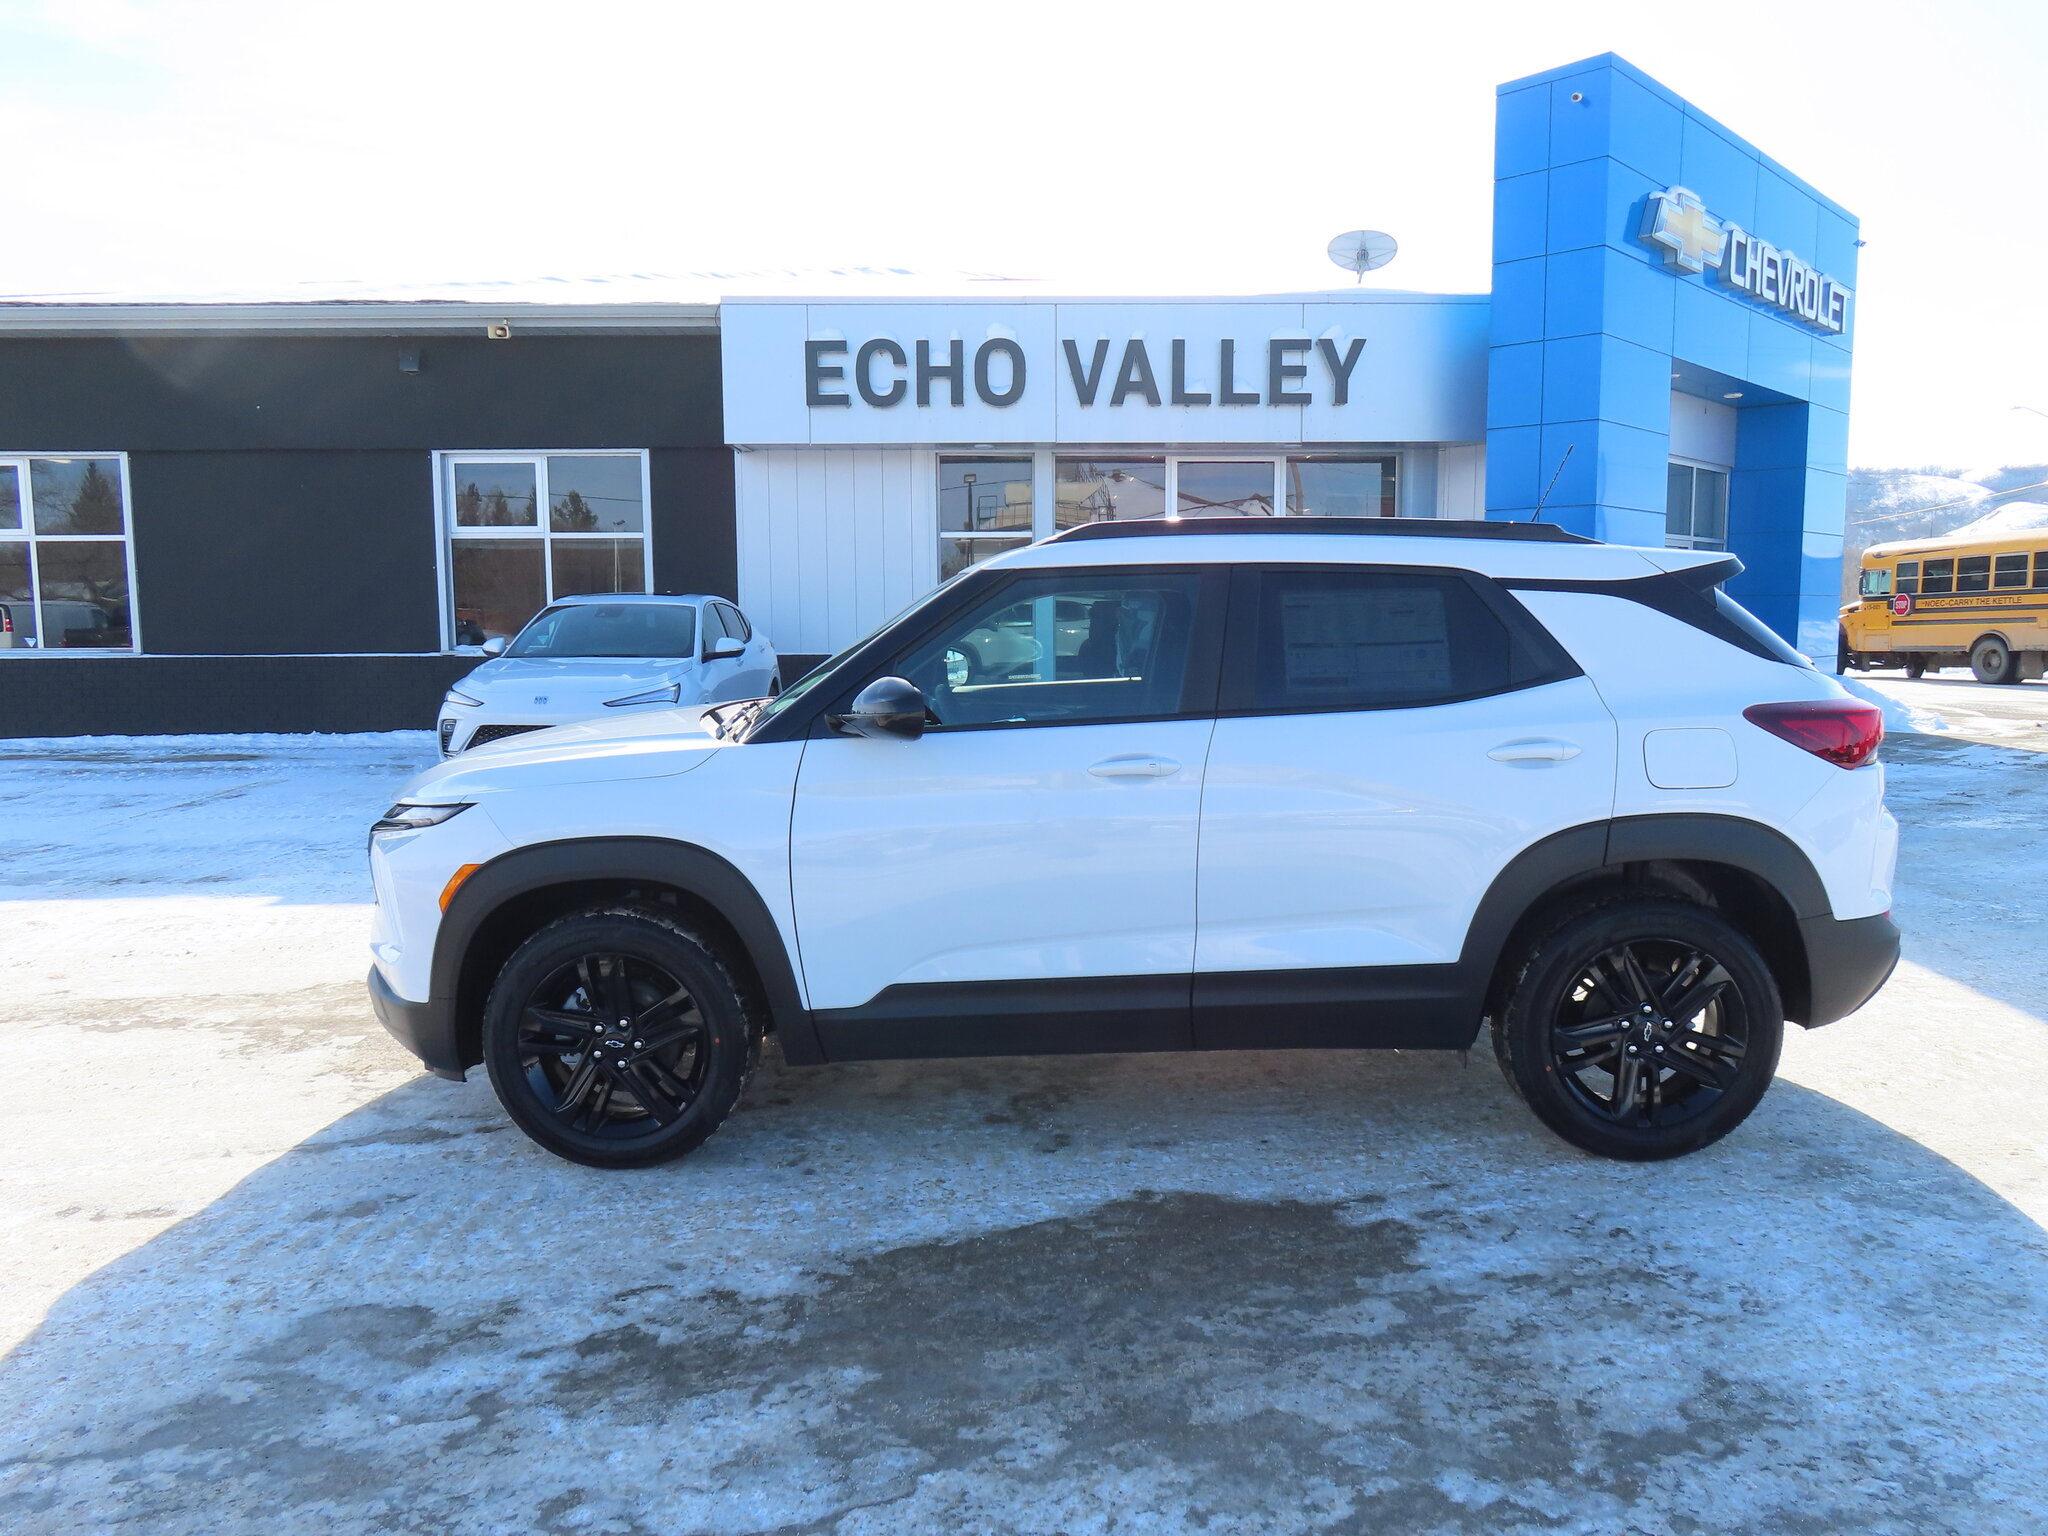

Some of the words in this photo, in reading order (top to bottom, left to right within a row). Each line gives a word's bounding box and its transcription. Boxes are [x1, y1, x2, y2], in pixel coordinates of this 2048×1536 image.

[1728, 229, 1851, 334] CHEVROLET
[804, 337, 1027, 408] ECHO
[1061, 338, 1367, 406] VALLEY
[1895, 600, 1908, 610] STOP
[1975, 597, 1991, 606] THE
[1992, 596, 2023, 605] KETTLE
